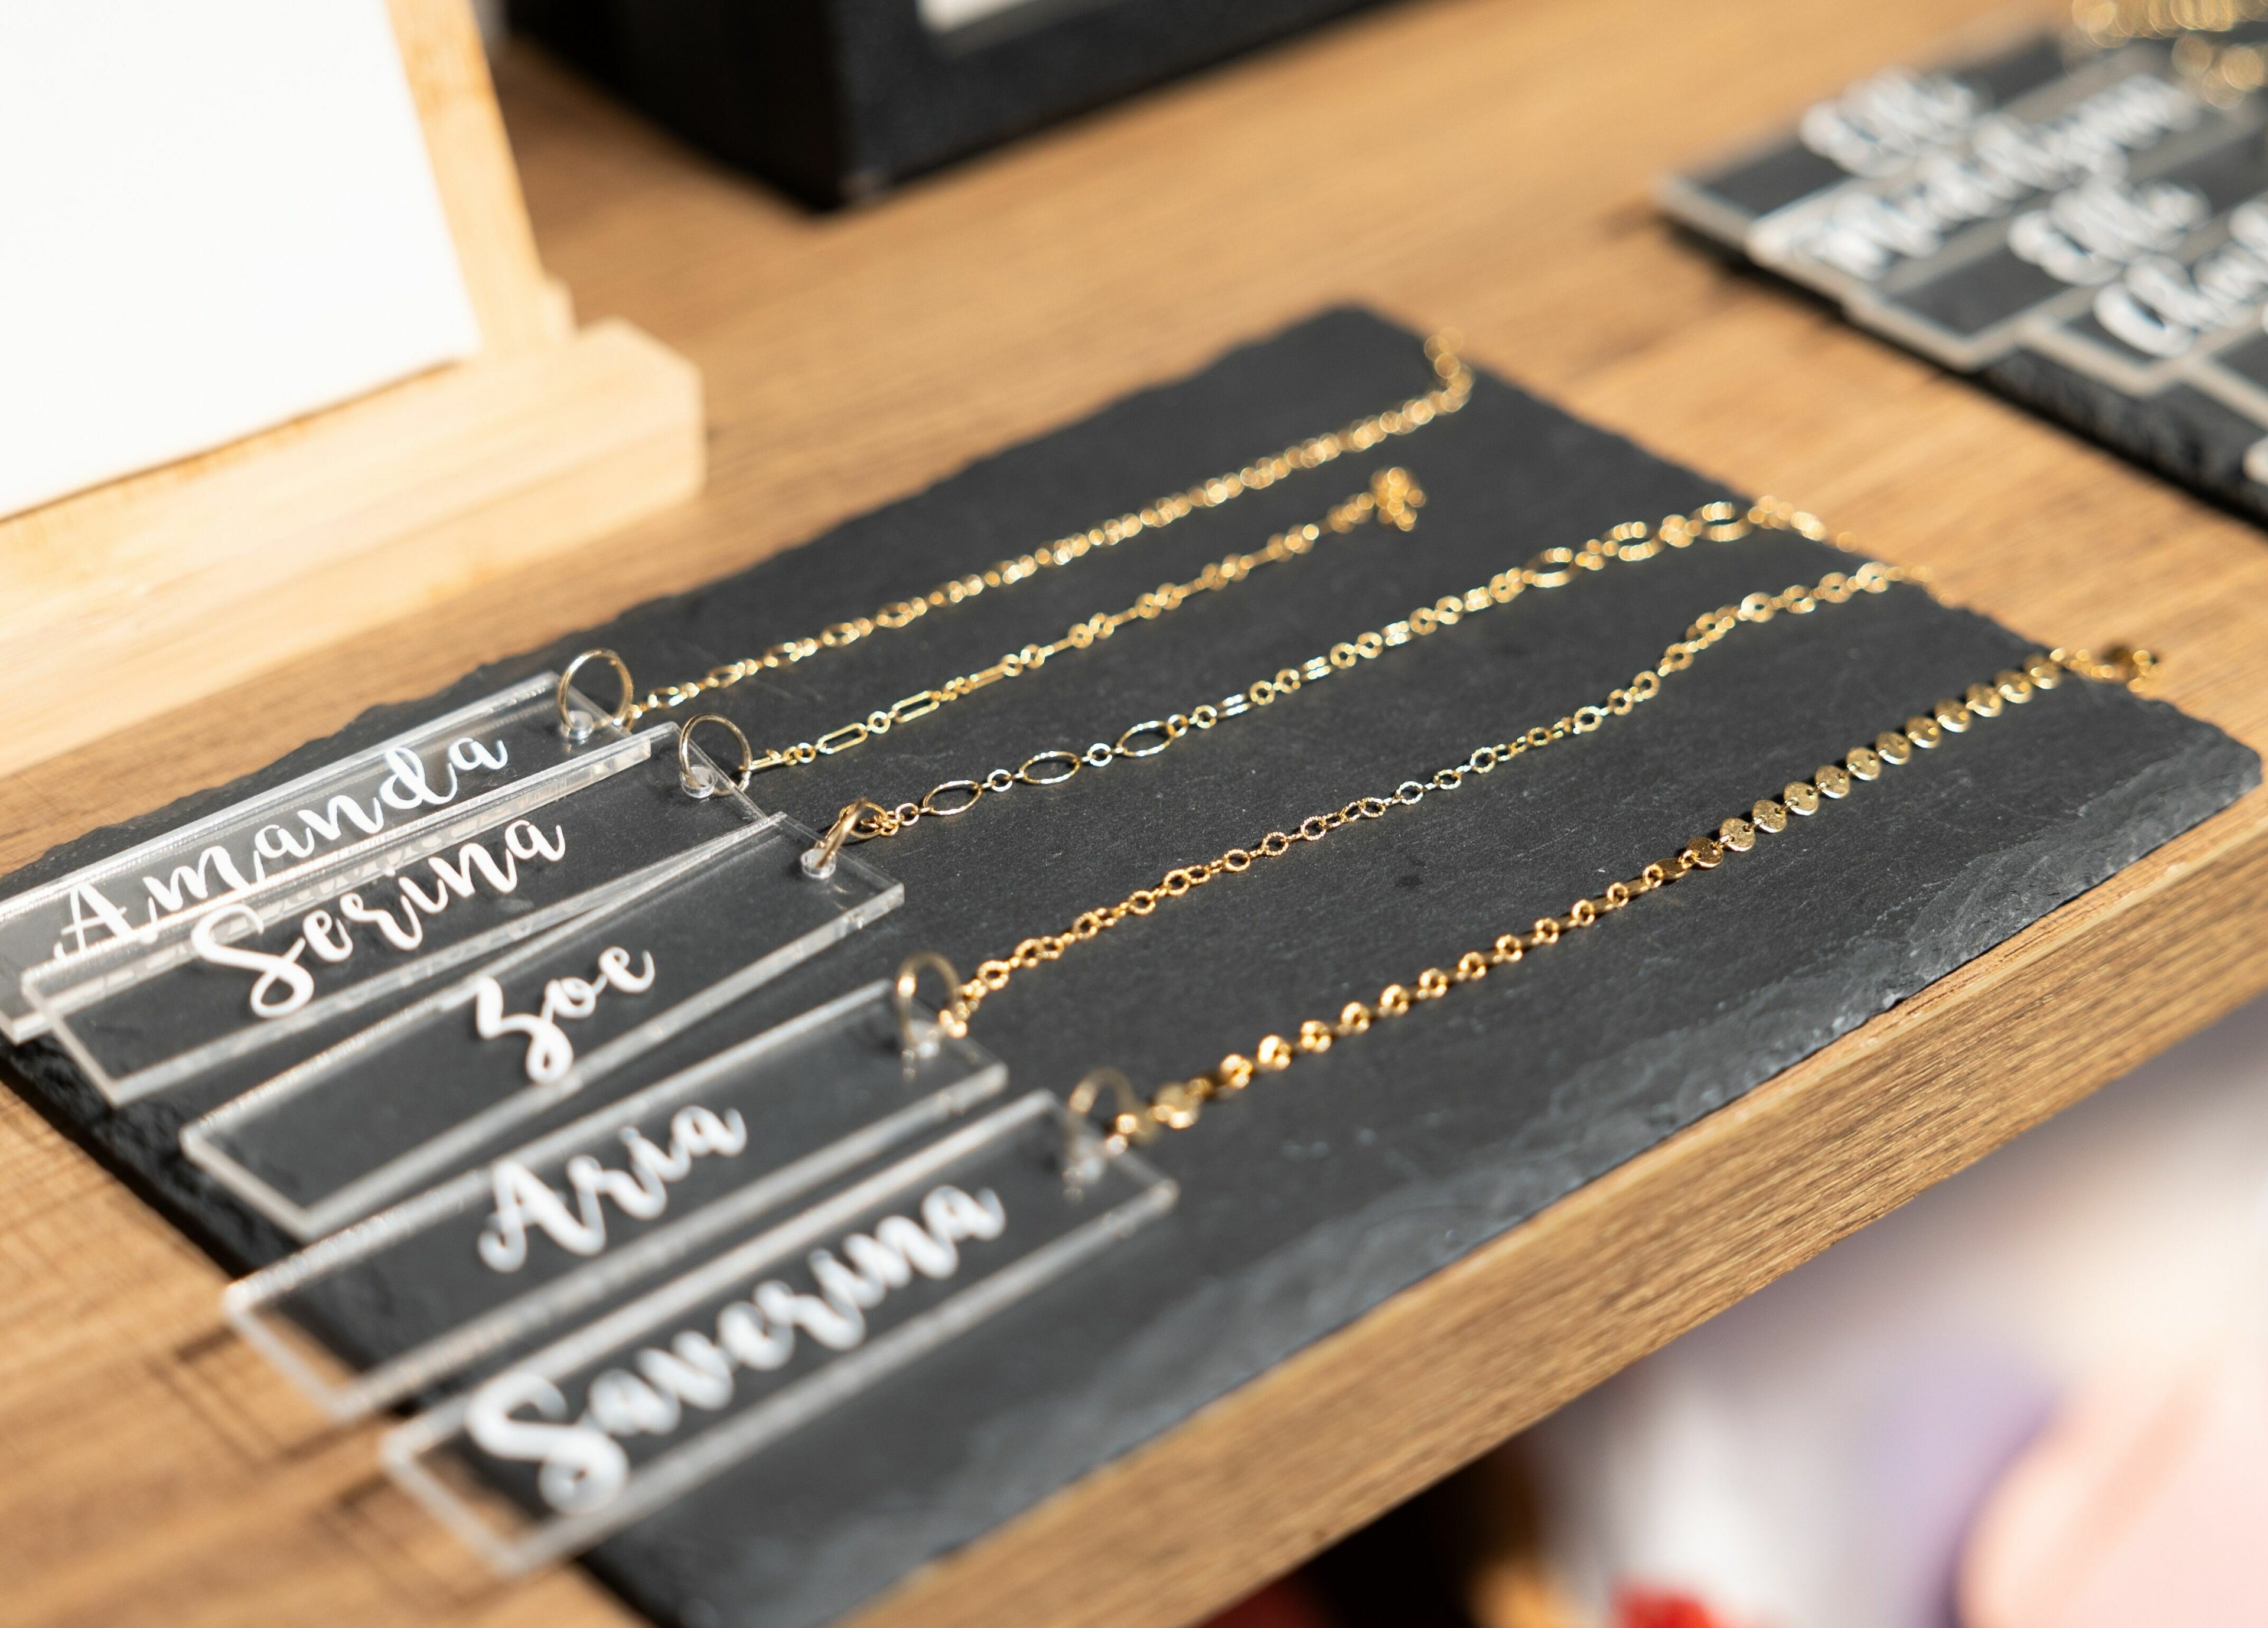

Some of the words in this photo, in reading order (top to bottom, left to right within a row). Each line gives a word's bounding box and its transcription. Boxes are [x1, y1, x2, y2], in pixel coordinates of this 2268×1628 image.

[54, 736, 508, 962] Amanda
[192, 820, 565, 1017] Serina
[476, 946, 656, 1084] Zoe
[479, 1106, 747, 1272] Aria
[465, 1185, 1005, 1515] Saverina
